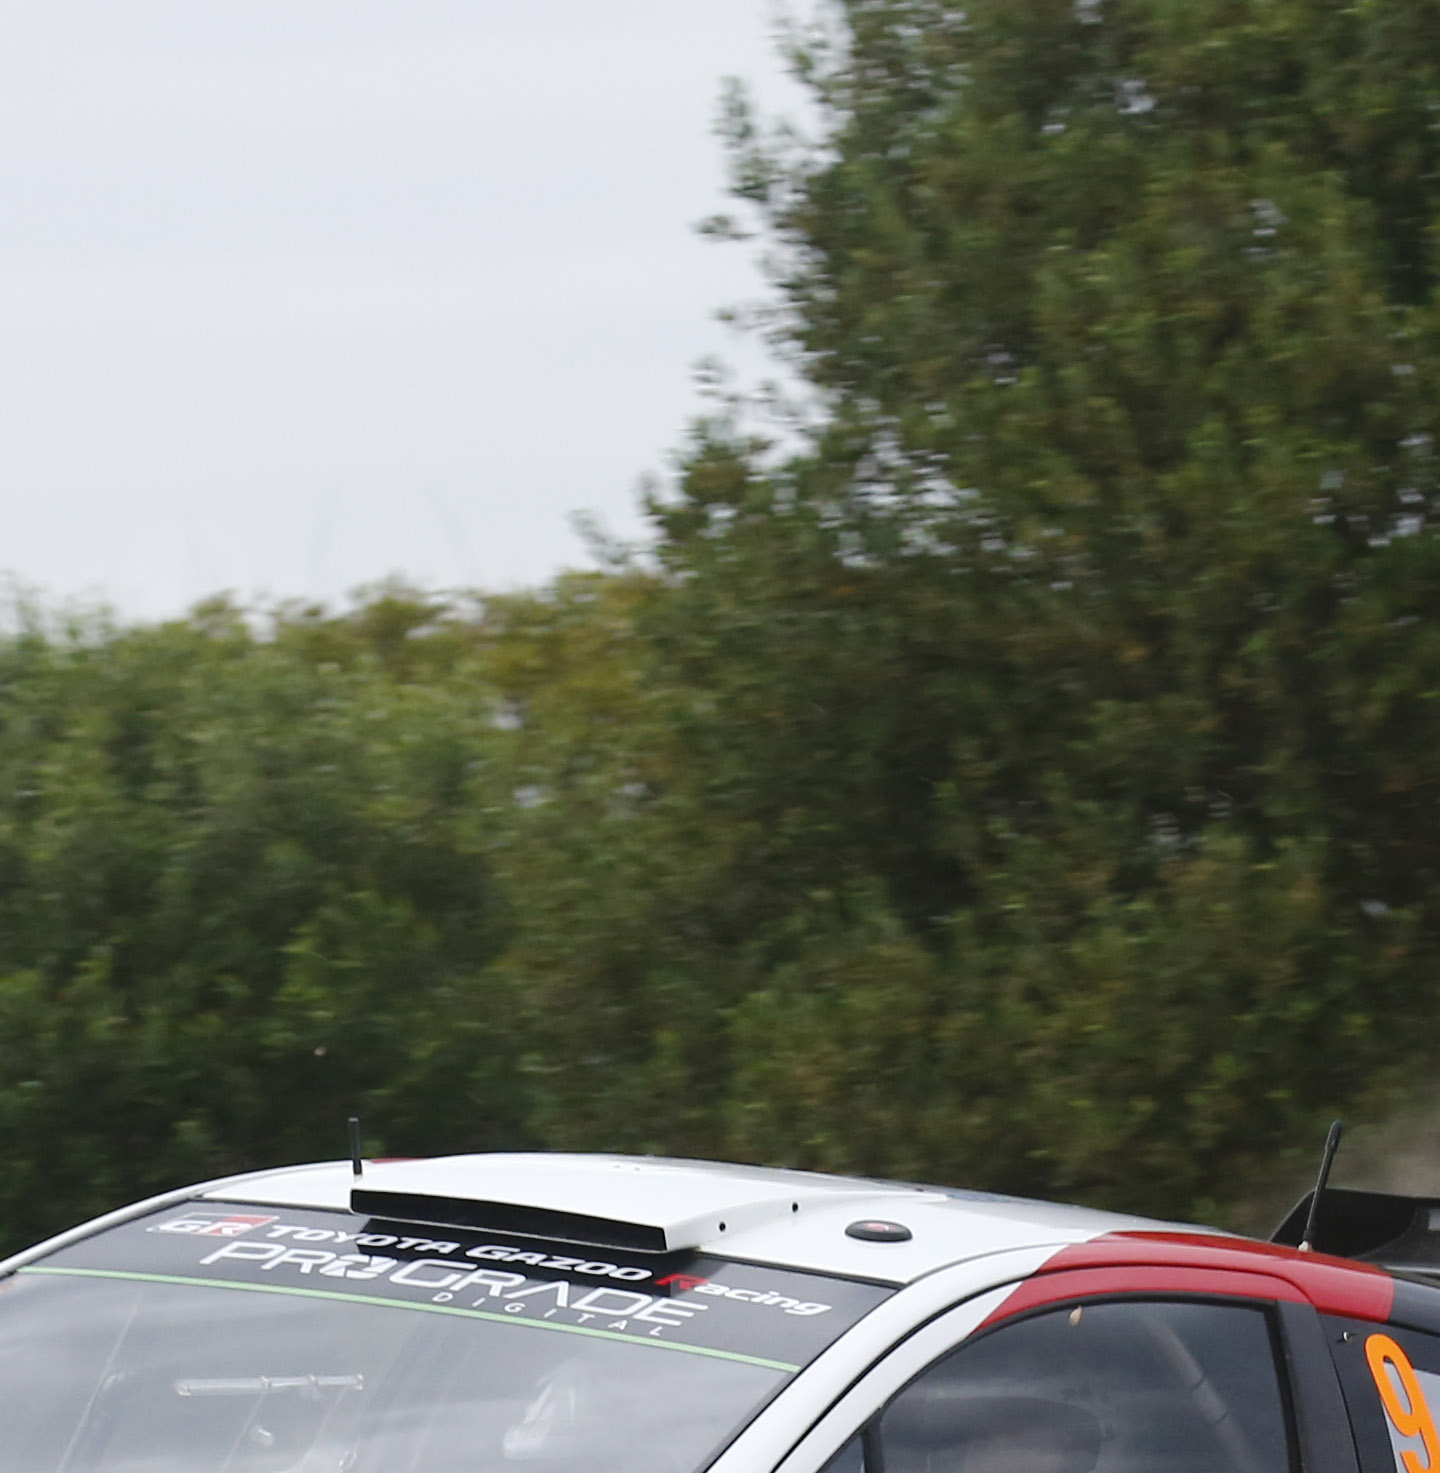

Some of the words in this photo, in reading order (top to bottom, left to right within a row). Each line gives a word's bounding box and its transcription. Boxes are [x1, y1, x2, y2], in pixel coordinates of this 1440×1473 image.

[199, 1241, 709, 1328] PROGRADE
[267, 1224, 459, 1255] TOYOTA
[468, 1244, 653, 1283] GAZOO
[655, 1272, 832, 1317] Racing
[432, 1292, 665, 1337] DIGITAL
